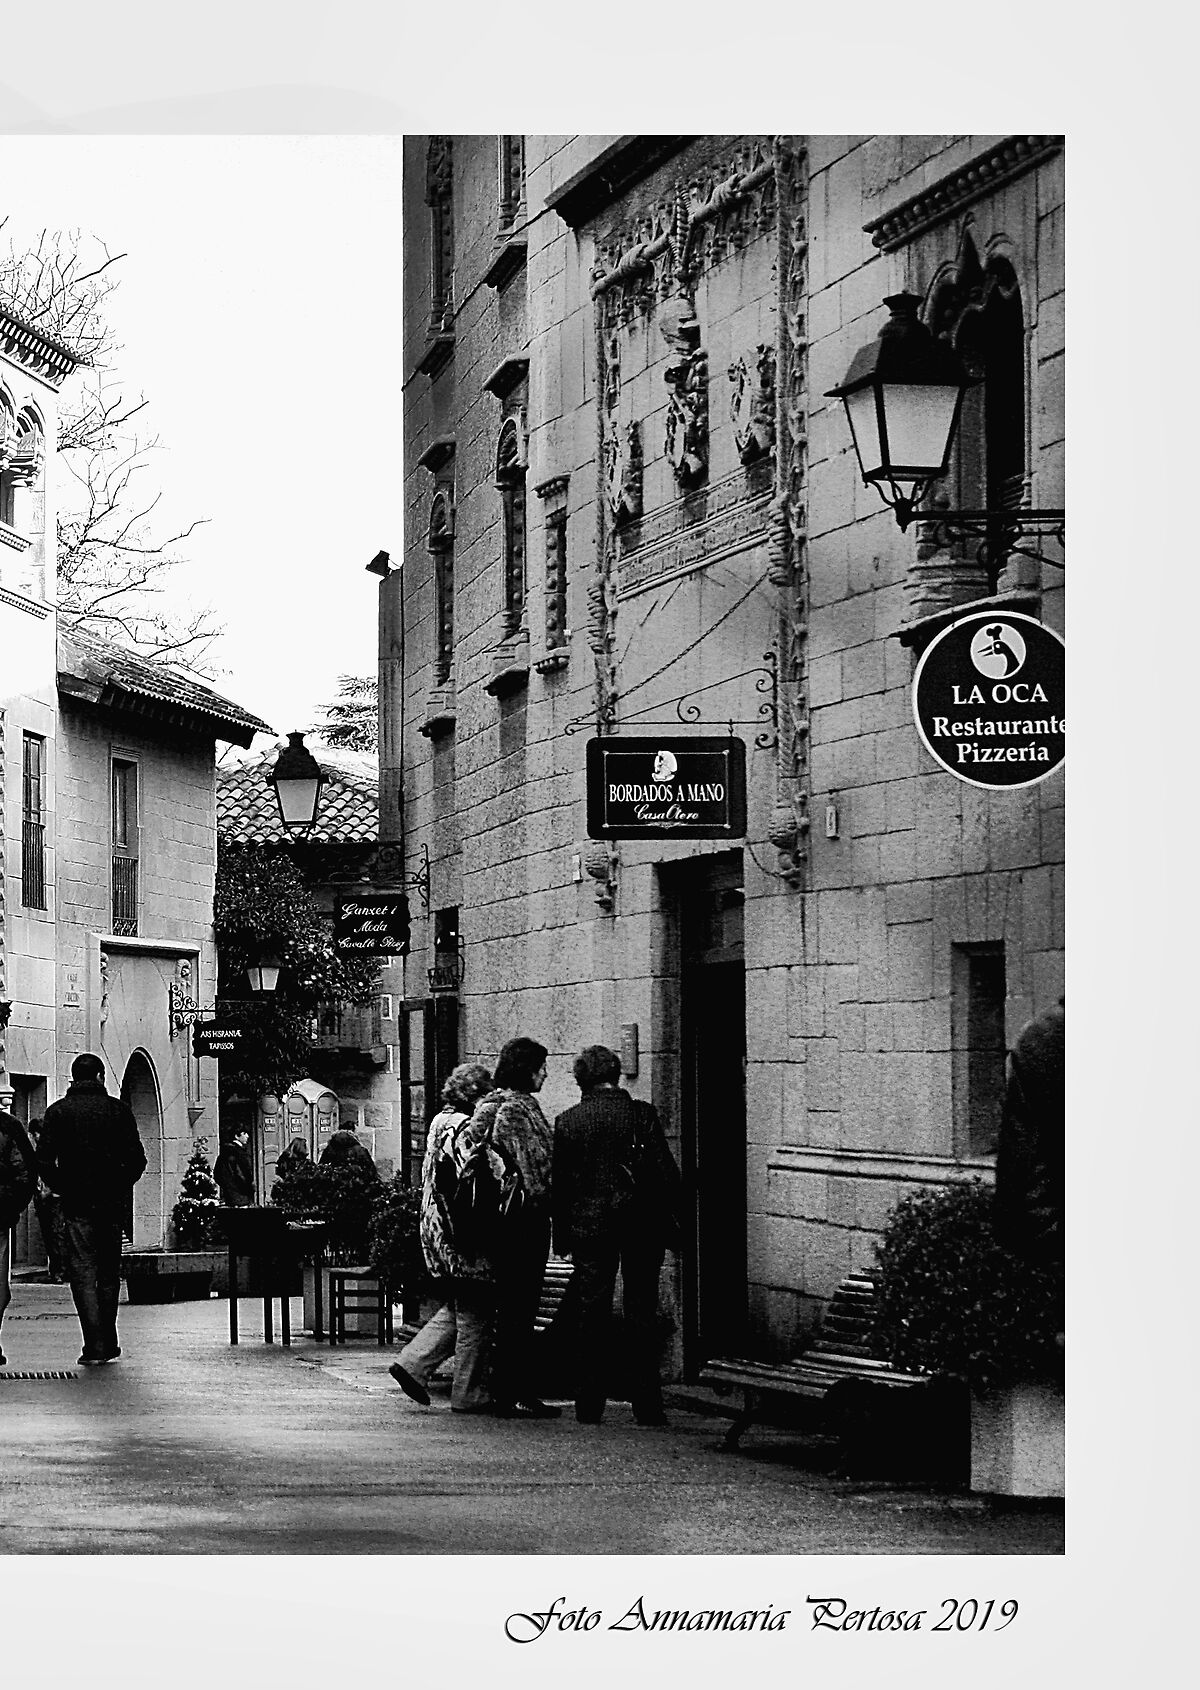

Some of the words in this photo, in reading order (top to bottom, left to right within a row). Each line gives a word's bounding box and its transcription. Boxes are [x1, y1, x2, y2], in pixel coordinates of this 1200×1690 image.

[951, 684, 986, 705] LA
[991, 683, 1049, 704] OCA
[956, 741, 1050, 763] Pizzería
[609, 784, 673, 802] BORDADOS
[676, 784, 685, 802] A
[687, 783, 724, 802] MANO
[633, 803, 665, 820] Casa
[666, 803, 699, 820] Otero
